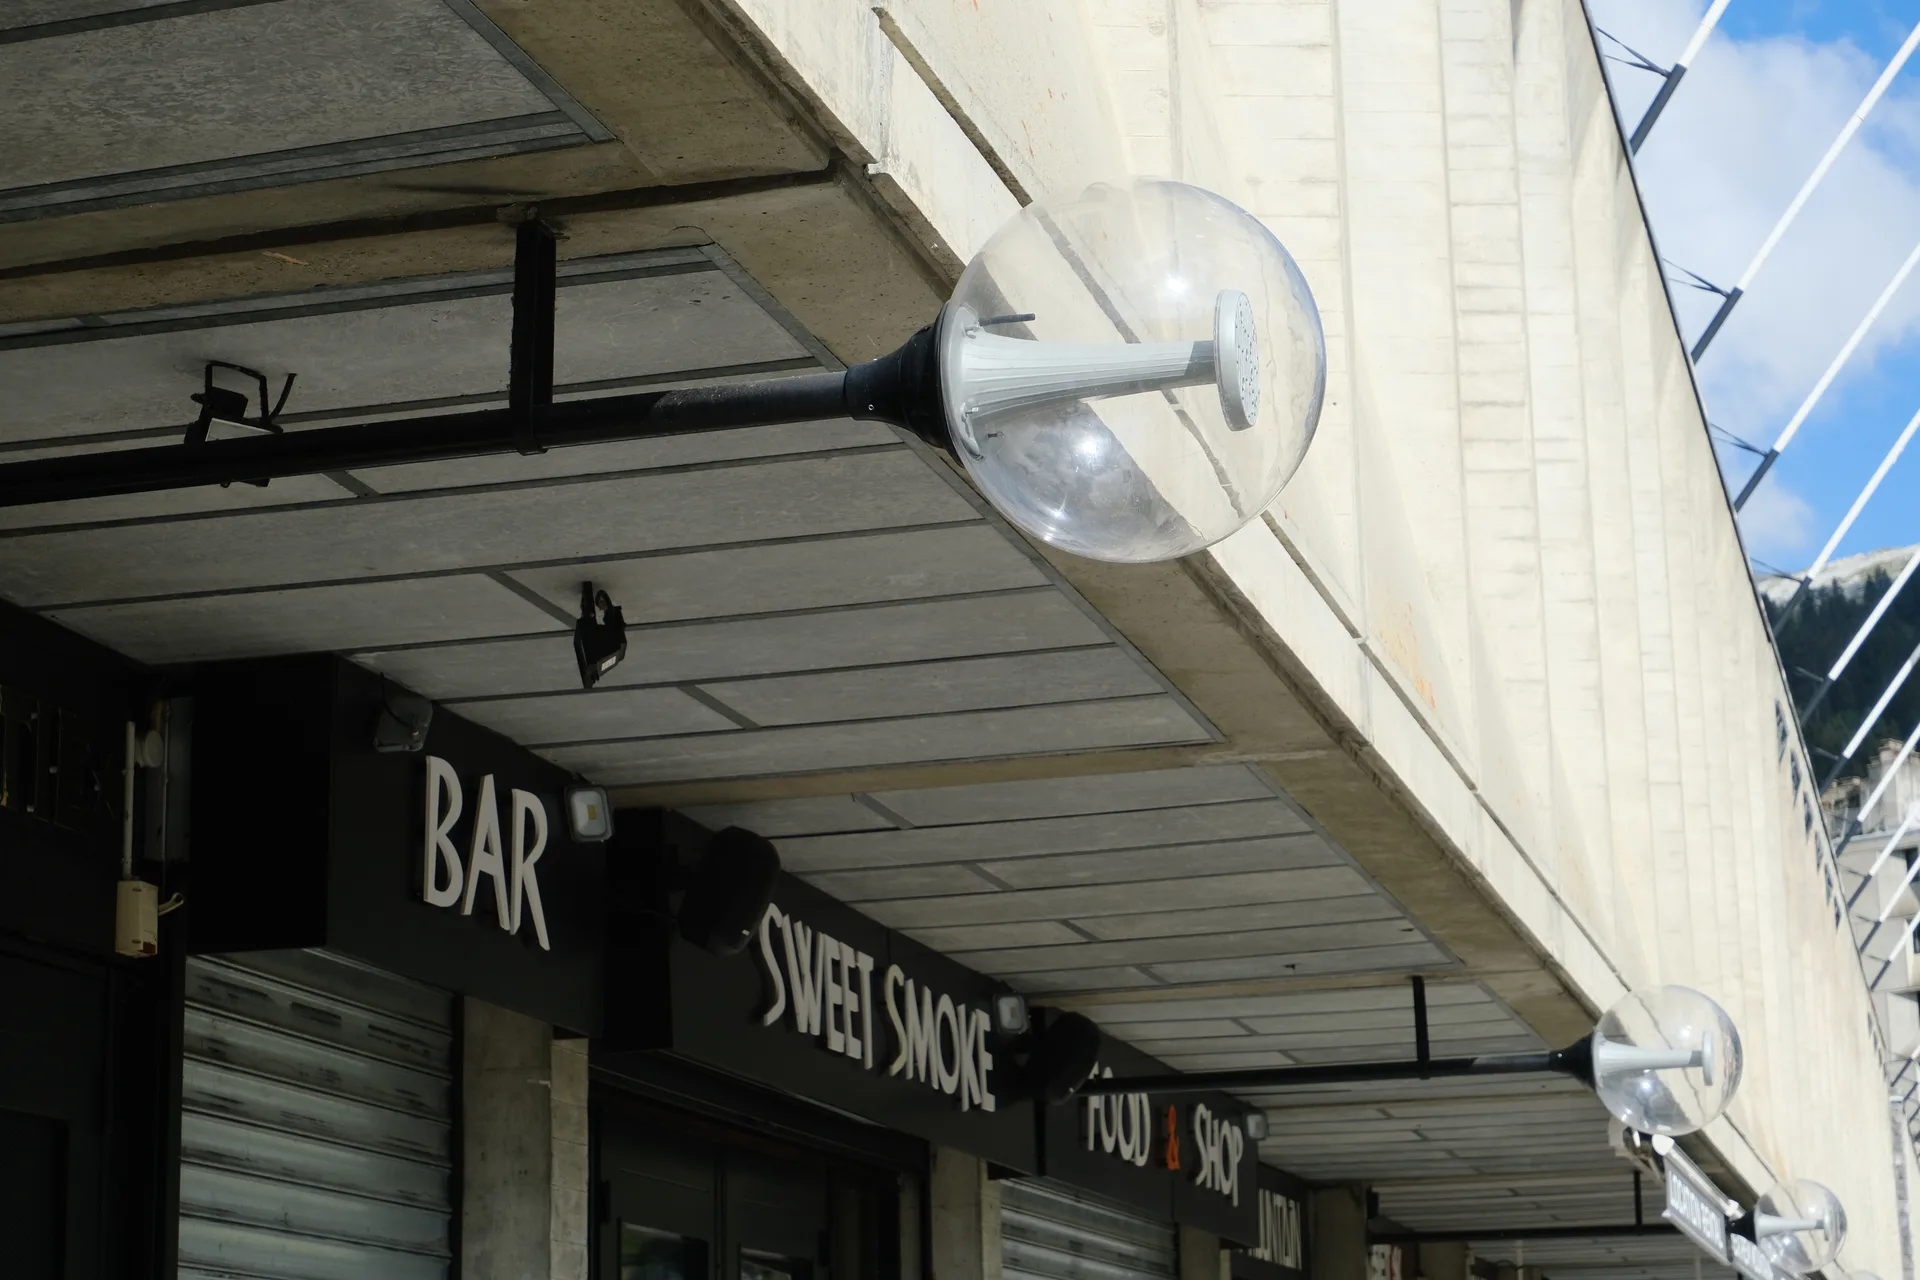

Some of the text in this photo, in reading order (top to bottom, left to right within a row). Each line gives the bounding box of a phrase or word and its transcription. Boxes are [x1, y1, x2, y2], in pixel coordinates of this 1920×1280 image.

[424, 755, 550, 951] BAR
[759, 902, 996, 1113] SWEET SMOKE
[1088, 1060, 1244, 1208] FOOD & SHOP
